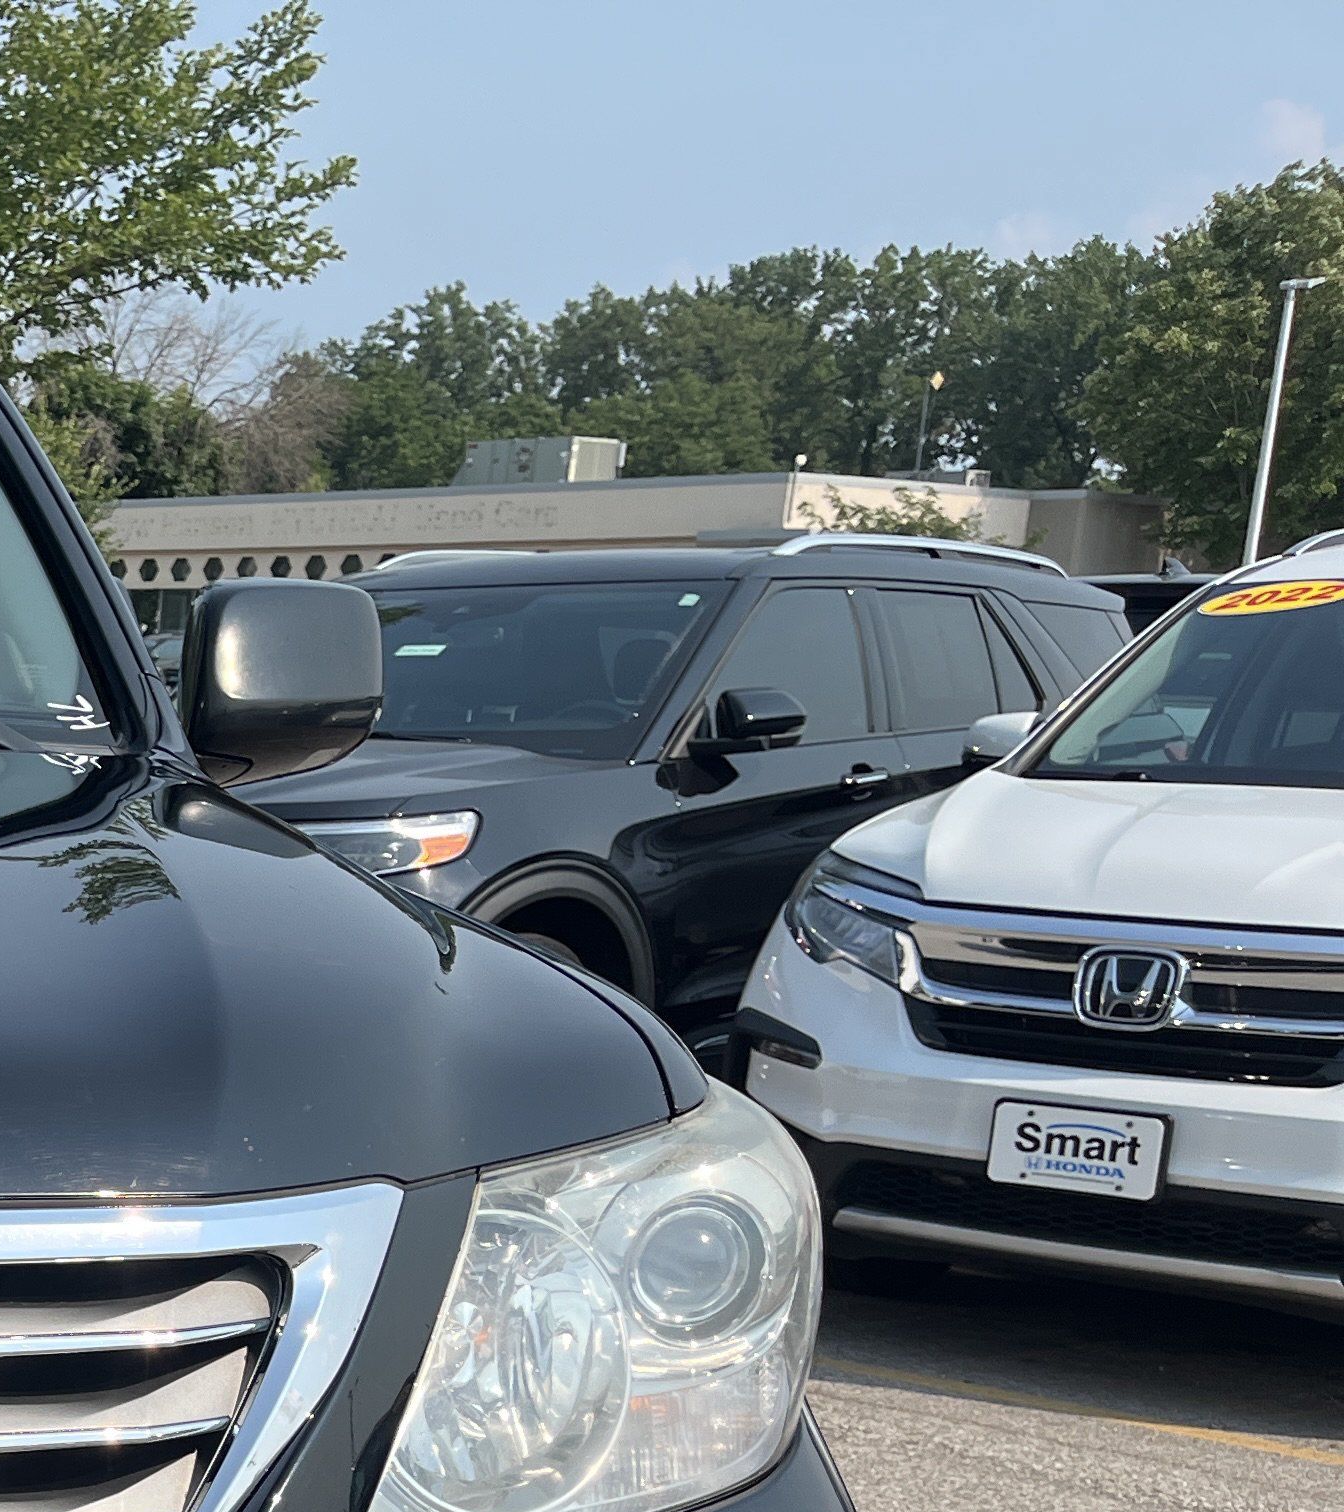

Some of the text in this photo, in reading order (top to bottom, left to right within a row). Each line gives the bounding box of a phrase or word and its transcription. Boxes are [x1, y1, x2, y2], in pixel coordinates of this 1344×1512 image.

[1215, 584, 1344, 612] 2022
[1014, 1121, 1141, 1166] Smart
[1043, 1158, 1126, 1180] HONDA
